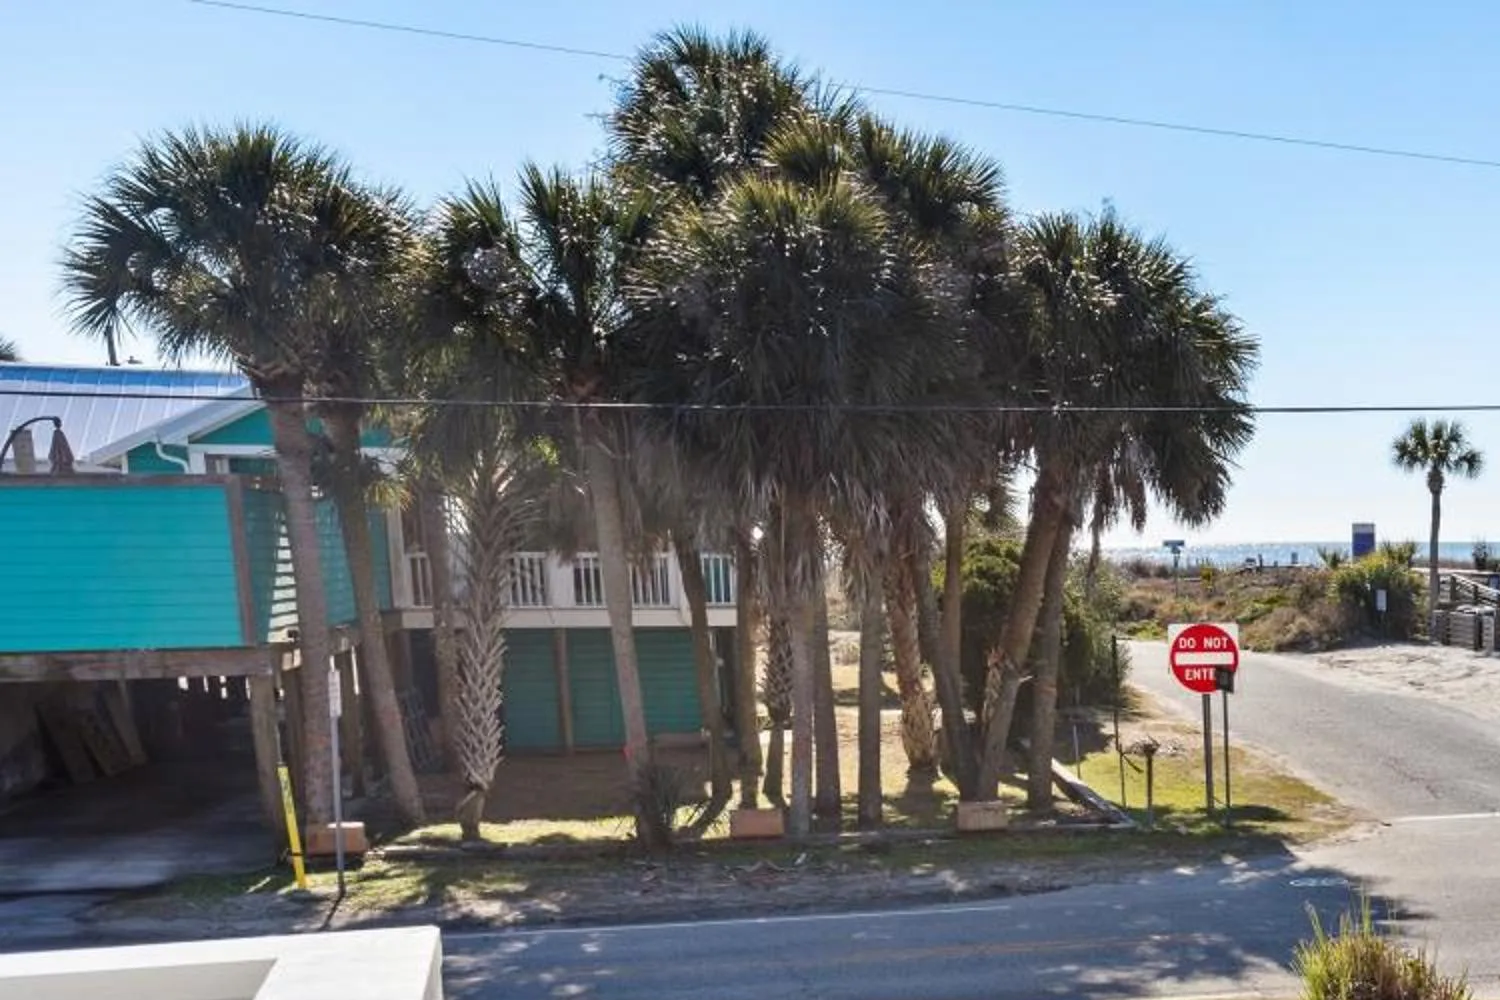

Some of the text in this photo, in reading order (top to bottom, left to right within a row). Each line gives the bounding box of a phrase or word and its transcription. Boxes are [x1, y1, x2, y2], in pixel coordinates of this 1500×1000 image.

[1179, 636, 1229, 649] DO NOT
[1185, 668, 1216, 681] ENTE
